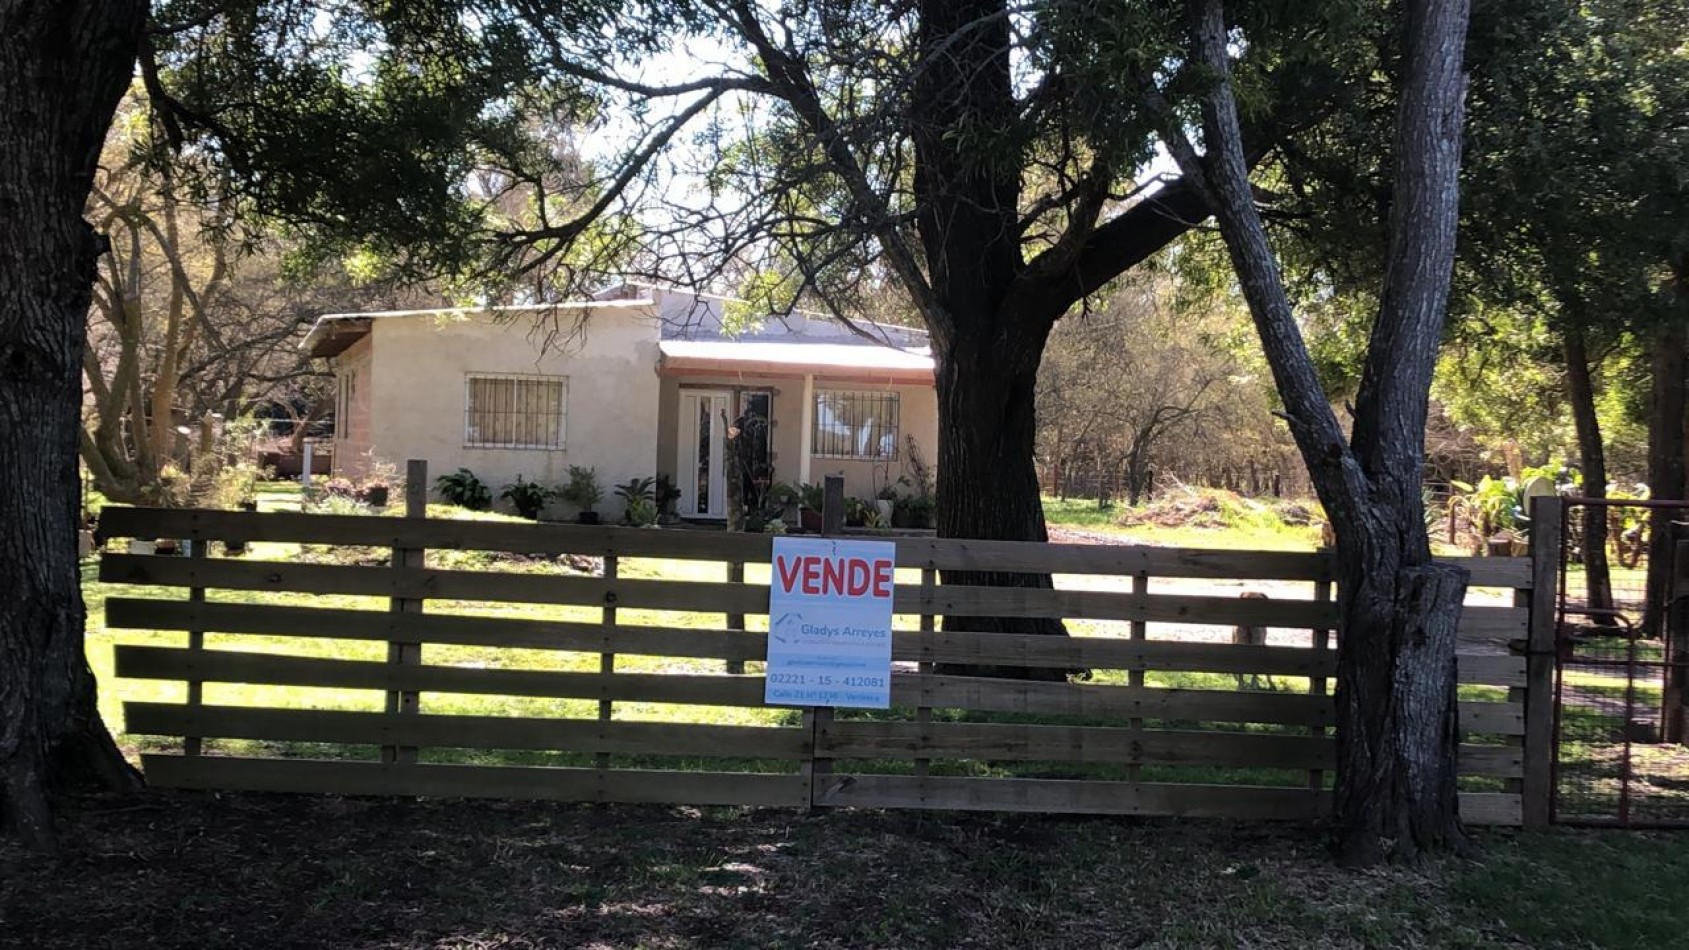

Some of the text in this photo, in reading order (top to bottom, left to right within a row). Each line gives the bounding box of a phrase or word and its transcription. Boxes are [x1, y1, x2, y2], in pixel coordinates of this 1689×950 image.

[776, 555, 893, 597] VENDE
[801, 624, 886, 639] Gladys Arreyes
[770, 673, 805, 684] 02221
[819, 675, 832, 684] 15
[843, 677, 885, 687] 412081
